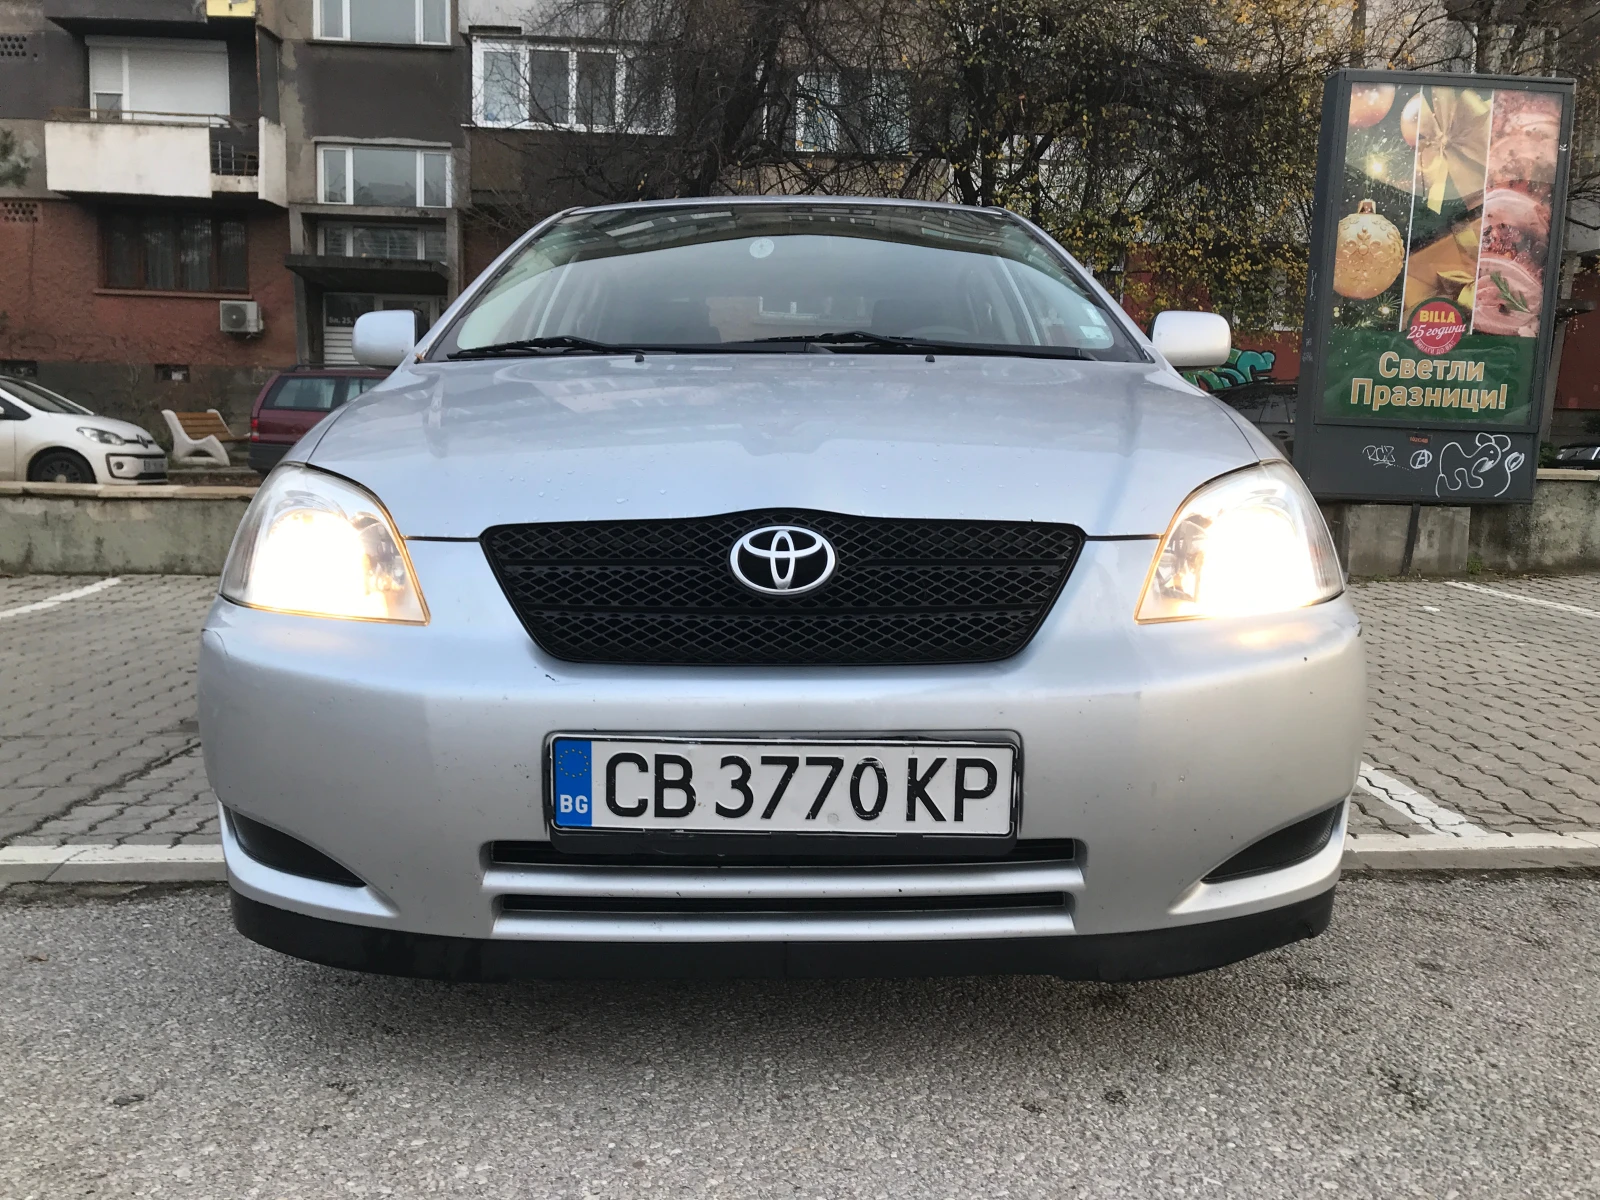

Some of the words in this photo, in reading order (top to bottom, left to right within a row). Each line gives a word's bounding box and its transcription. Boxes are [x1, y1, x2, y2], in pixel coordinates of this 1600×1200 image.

[1419, 310, 1456, 323] BILLA
[1406, 324, 1427, 339] 25
[1426, 324, 1467, 340] години
[1379, 351, 1485, 381] Светли
[1350, 377, 1508, 412] Празници!
[605, 752, 697, 818] CB
[715, 755, 889, 820] 3770
[905, 757, 998, 822] KP
[560, 794, 589, 814] BG
